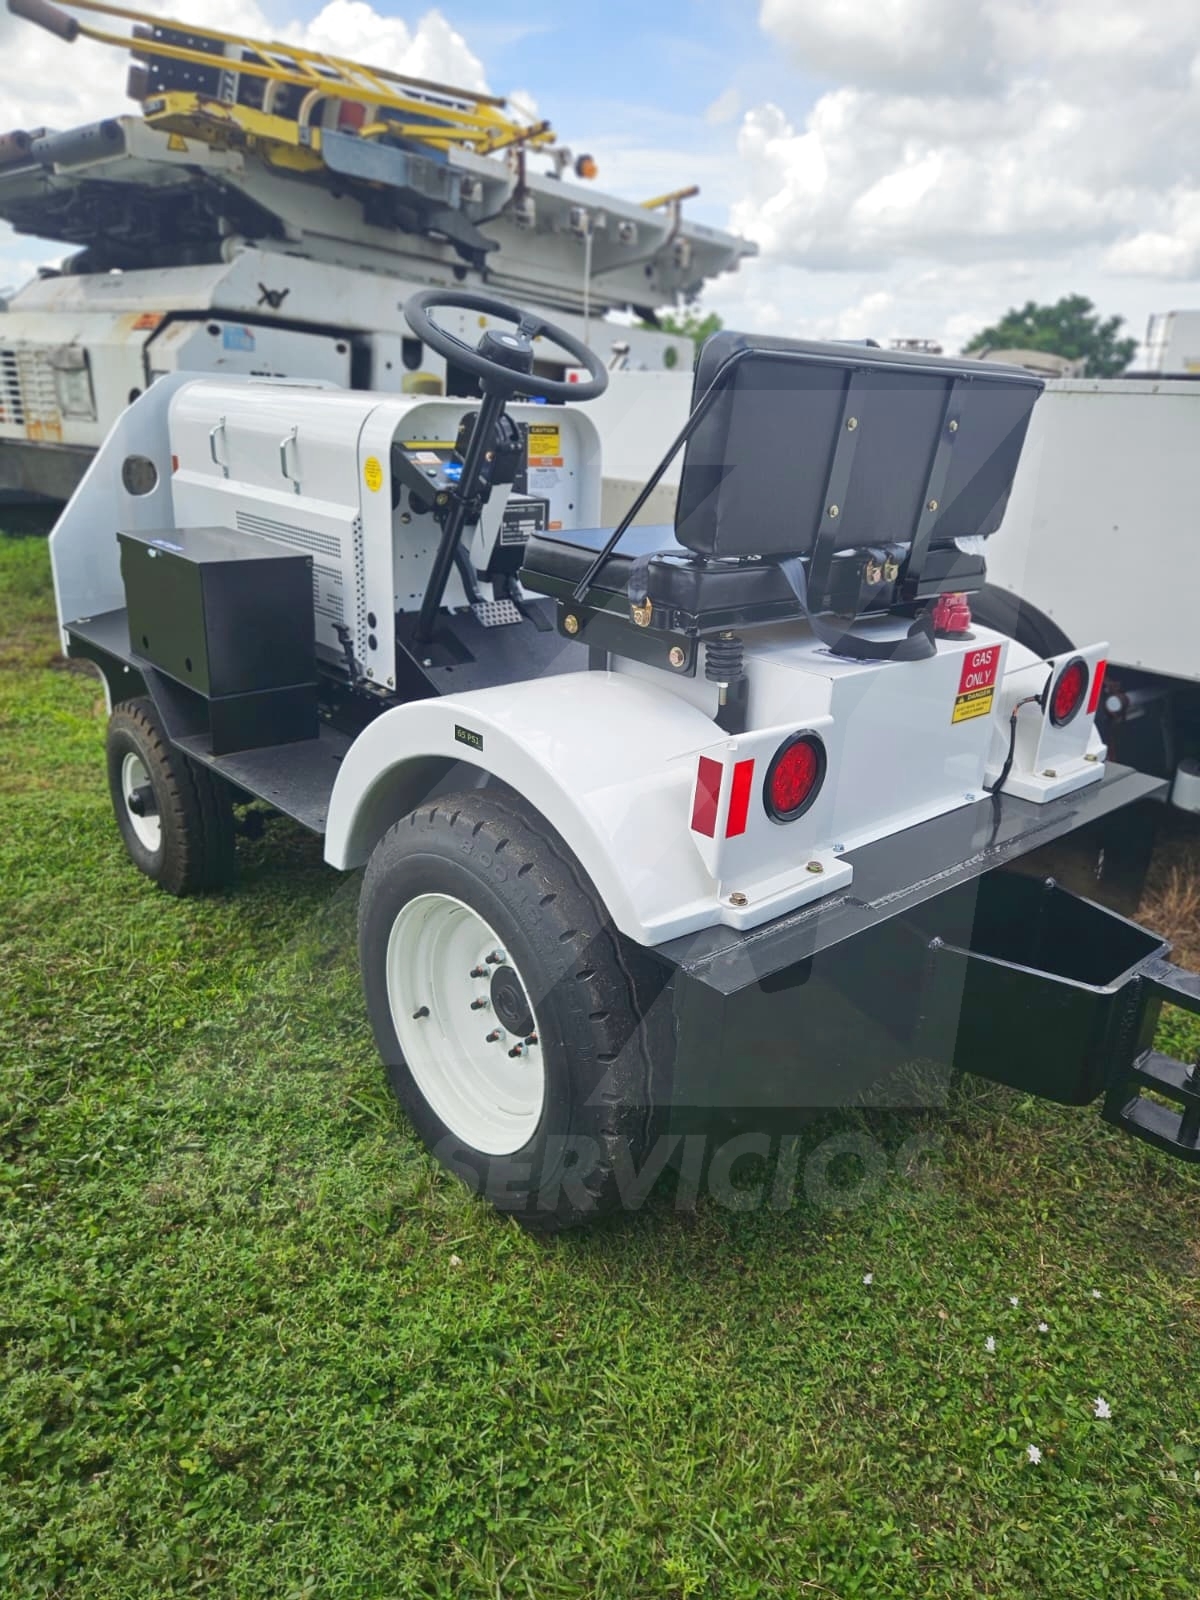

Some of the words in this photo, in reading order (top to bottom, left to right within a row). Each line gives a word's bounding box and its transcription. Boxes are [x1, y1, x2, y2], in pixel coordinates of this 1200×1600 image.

[973, 650, 992, 667] GAS
[966, 669, 992, 688] ONLY
[457, 729, 467, 739] 65
